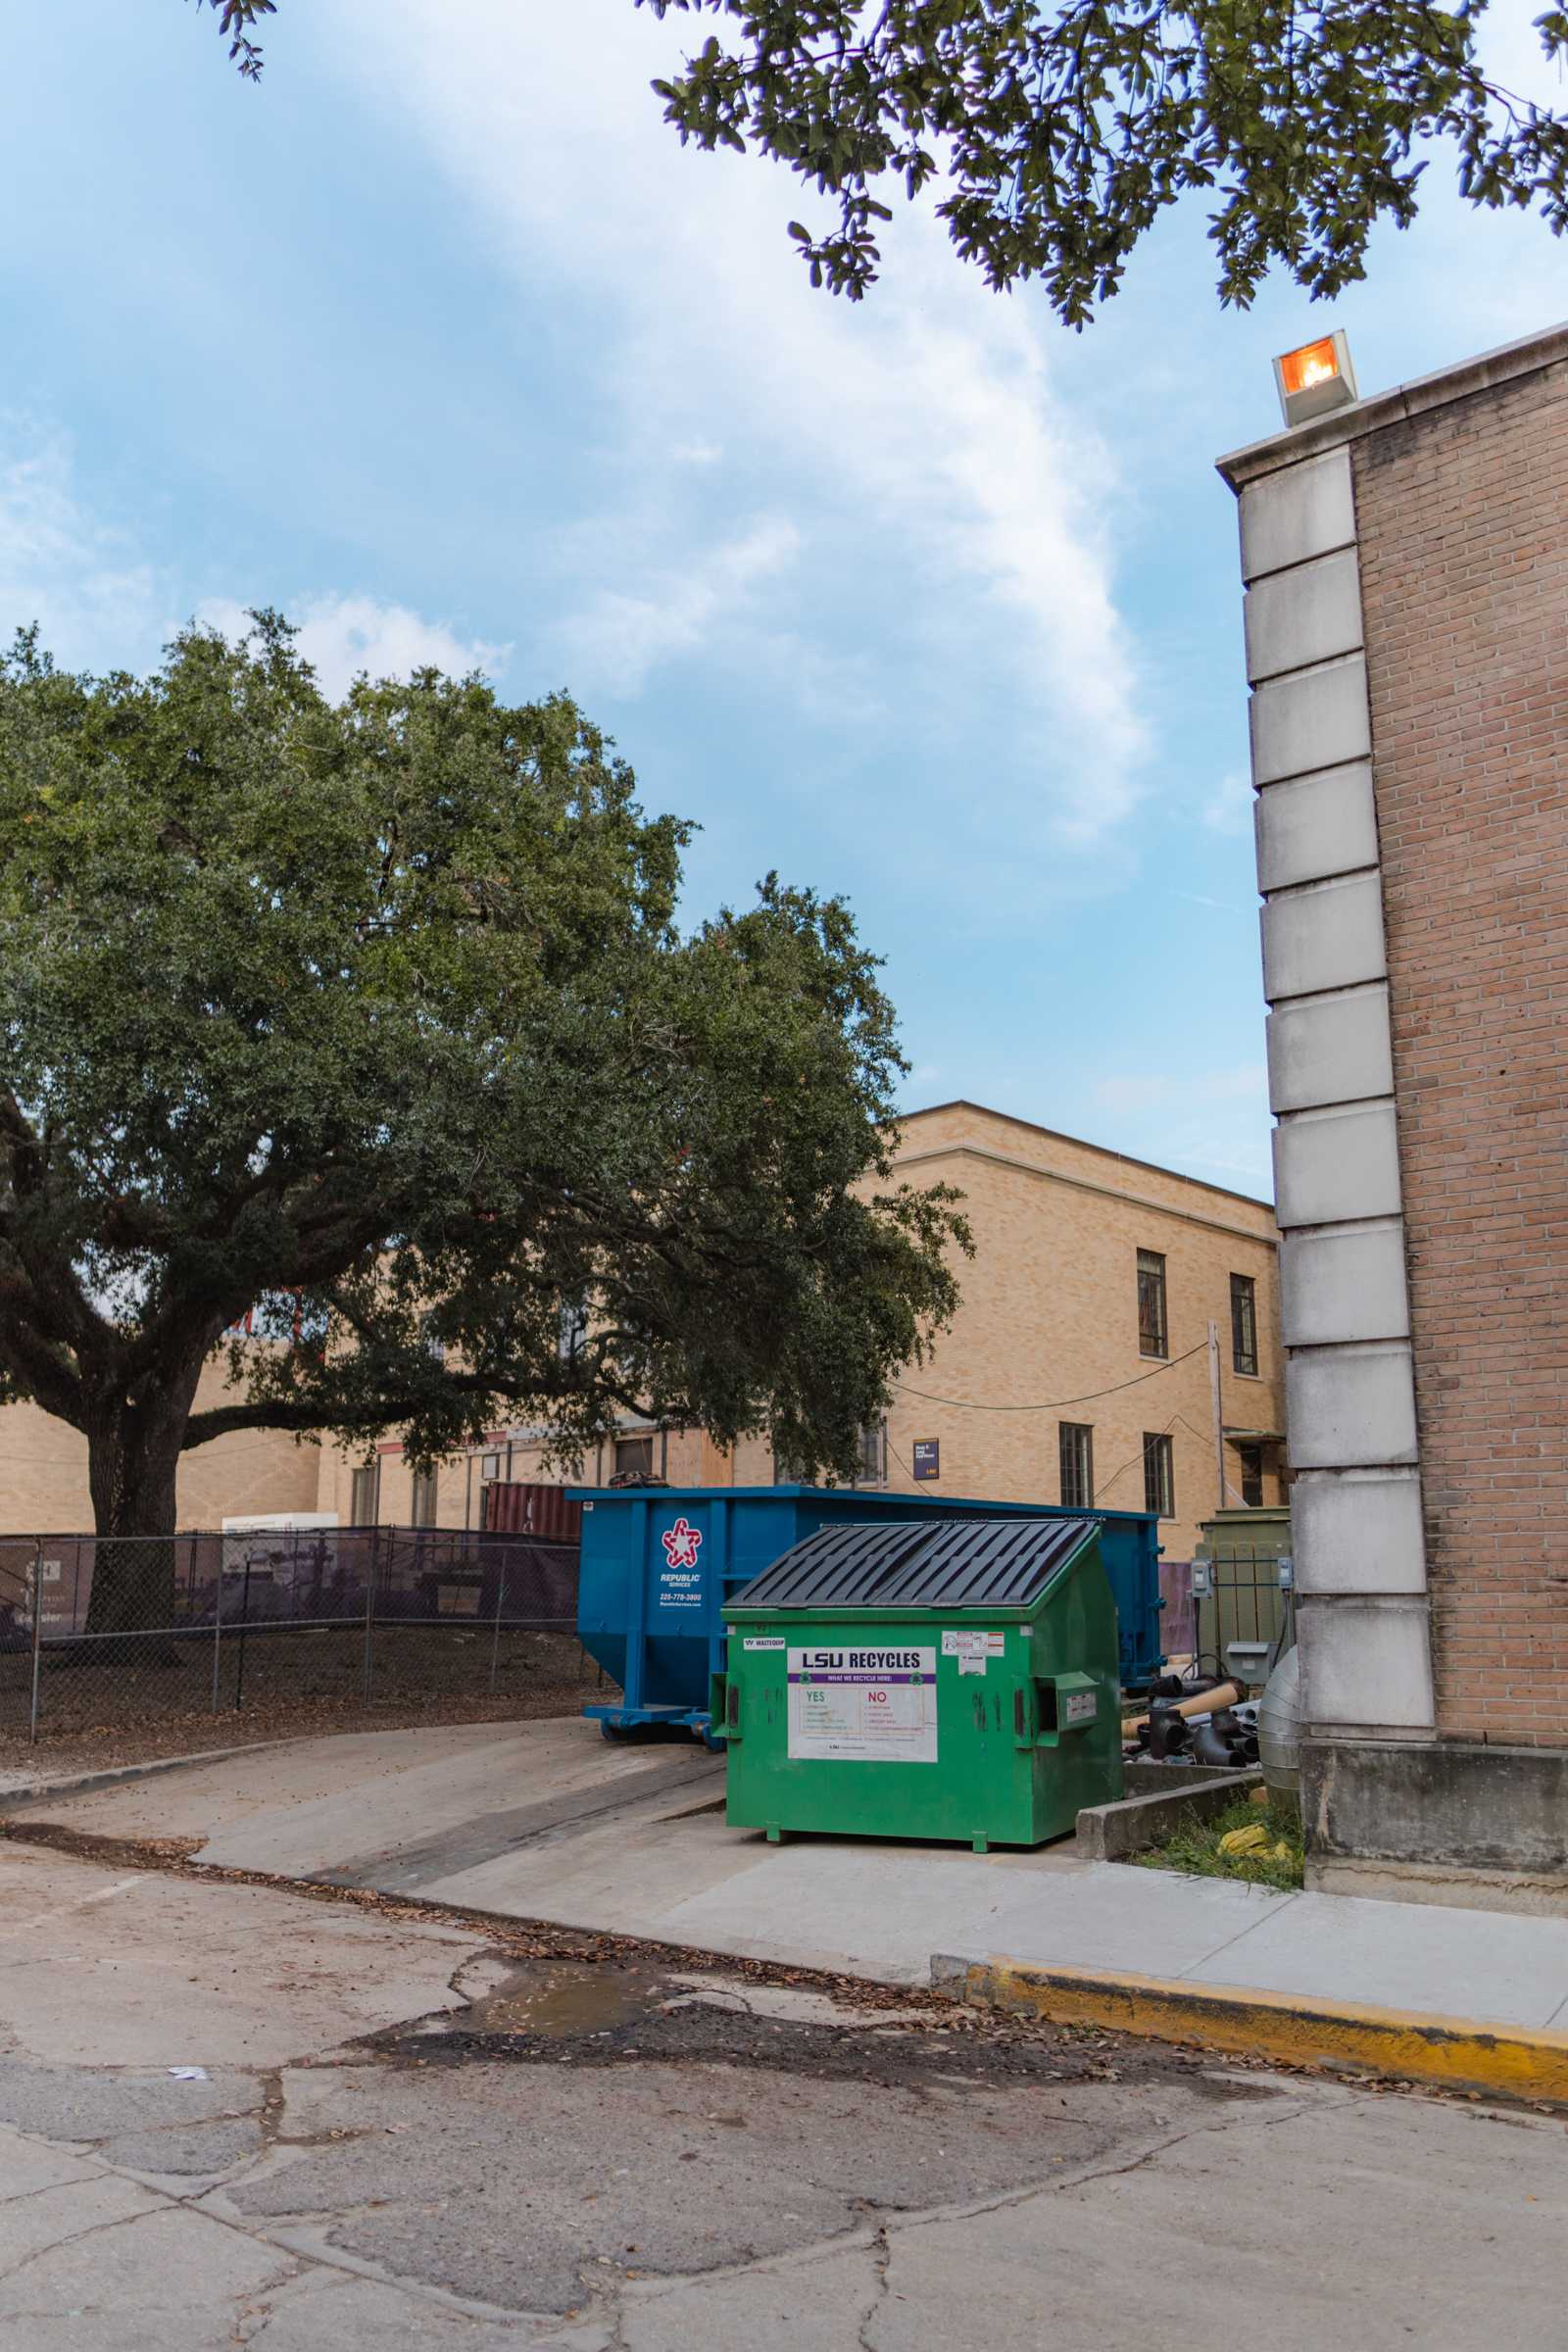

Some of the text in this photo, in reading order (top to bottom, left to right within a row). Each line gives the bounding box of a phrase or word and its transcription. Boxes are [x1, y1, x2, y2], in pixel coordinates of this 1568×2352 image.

[803, 1652, 921, 1669] LSU RECYCLES
[807, 1691, 887, 1703] YES NO
